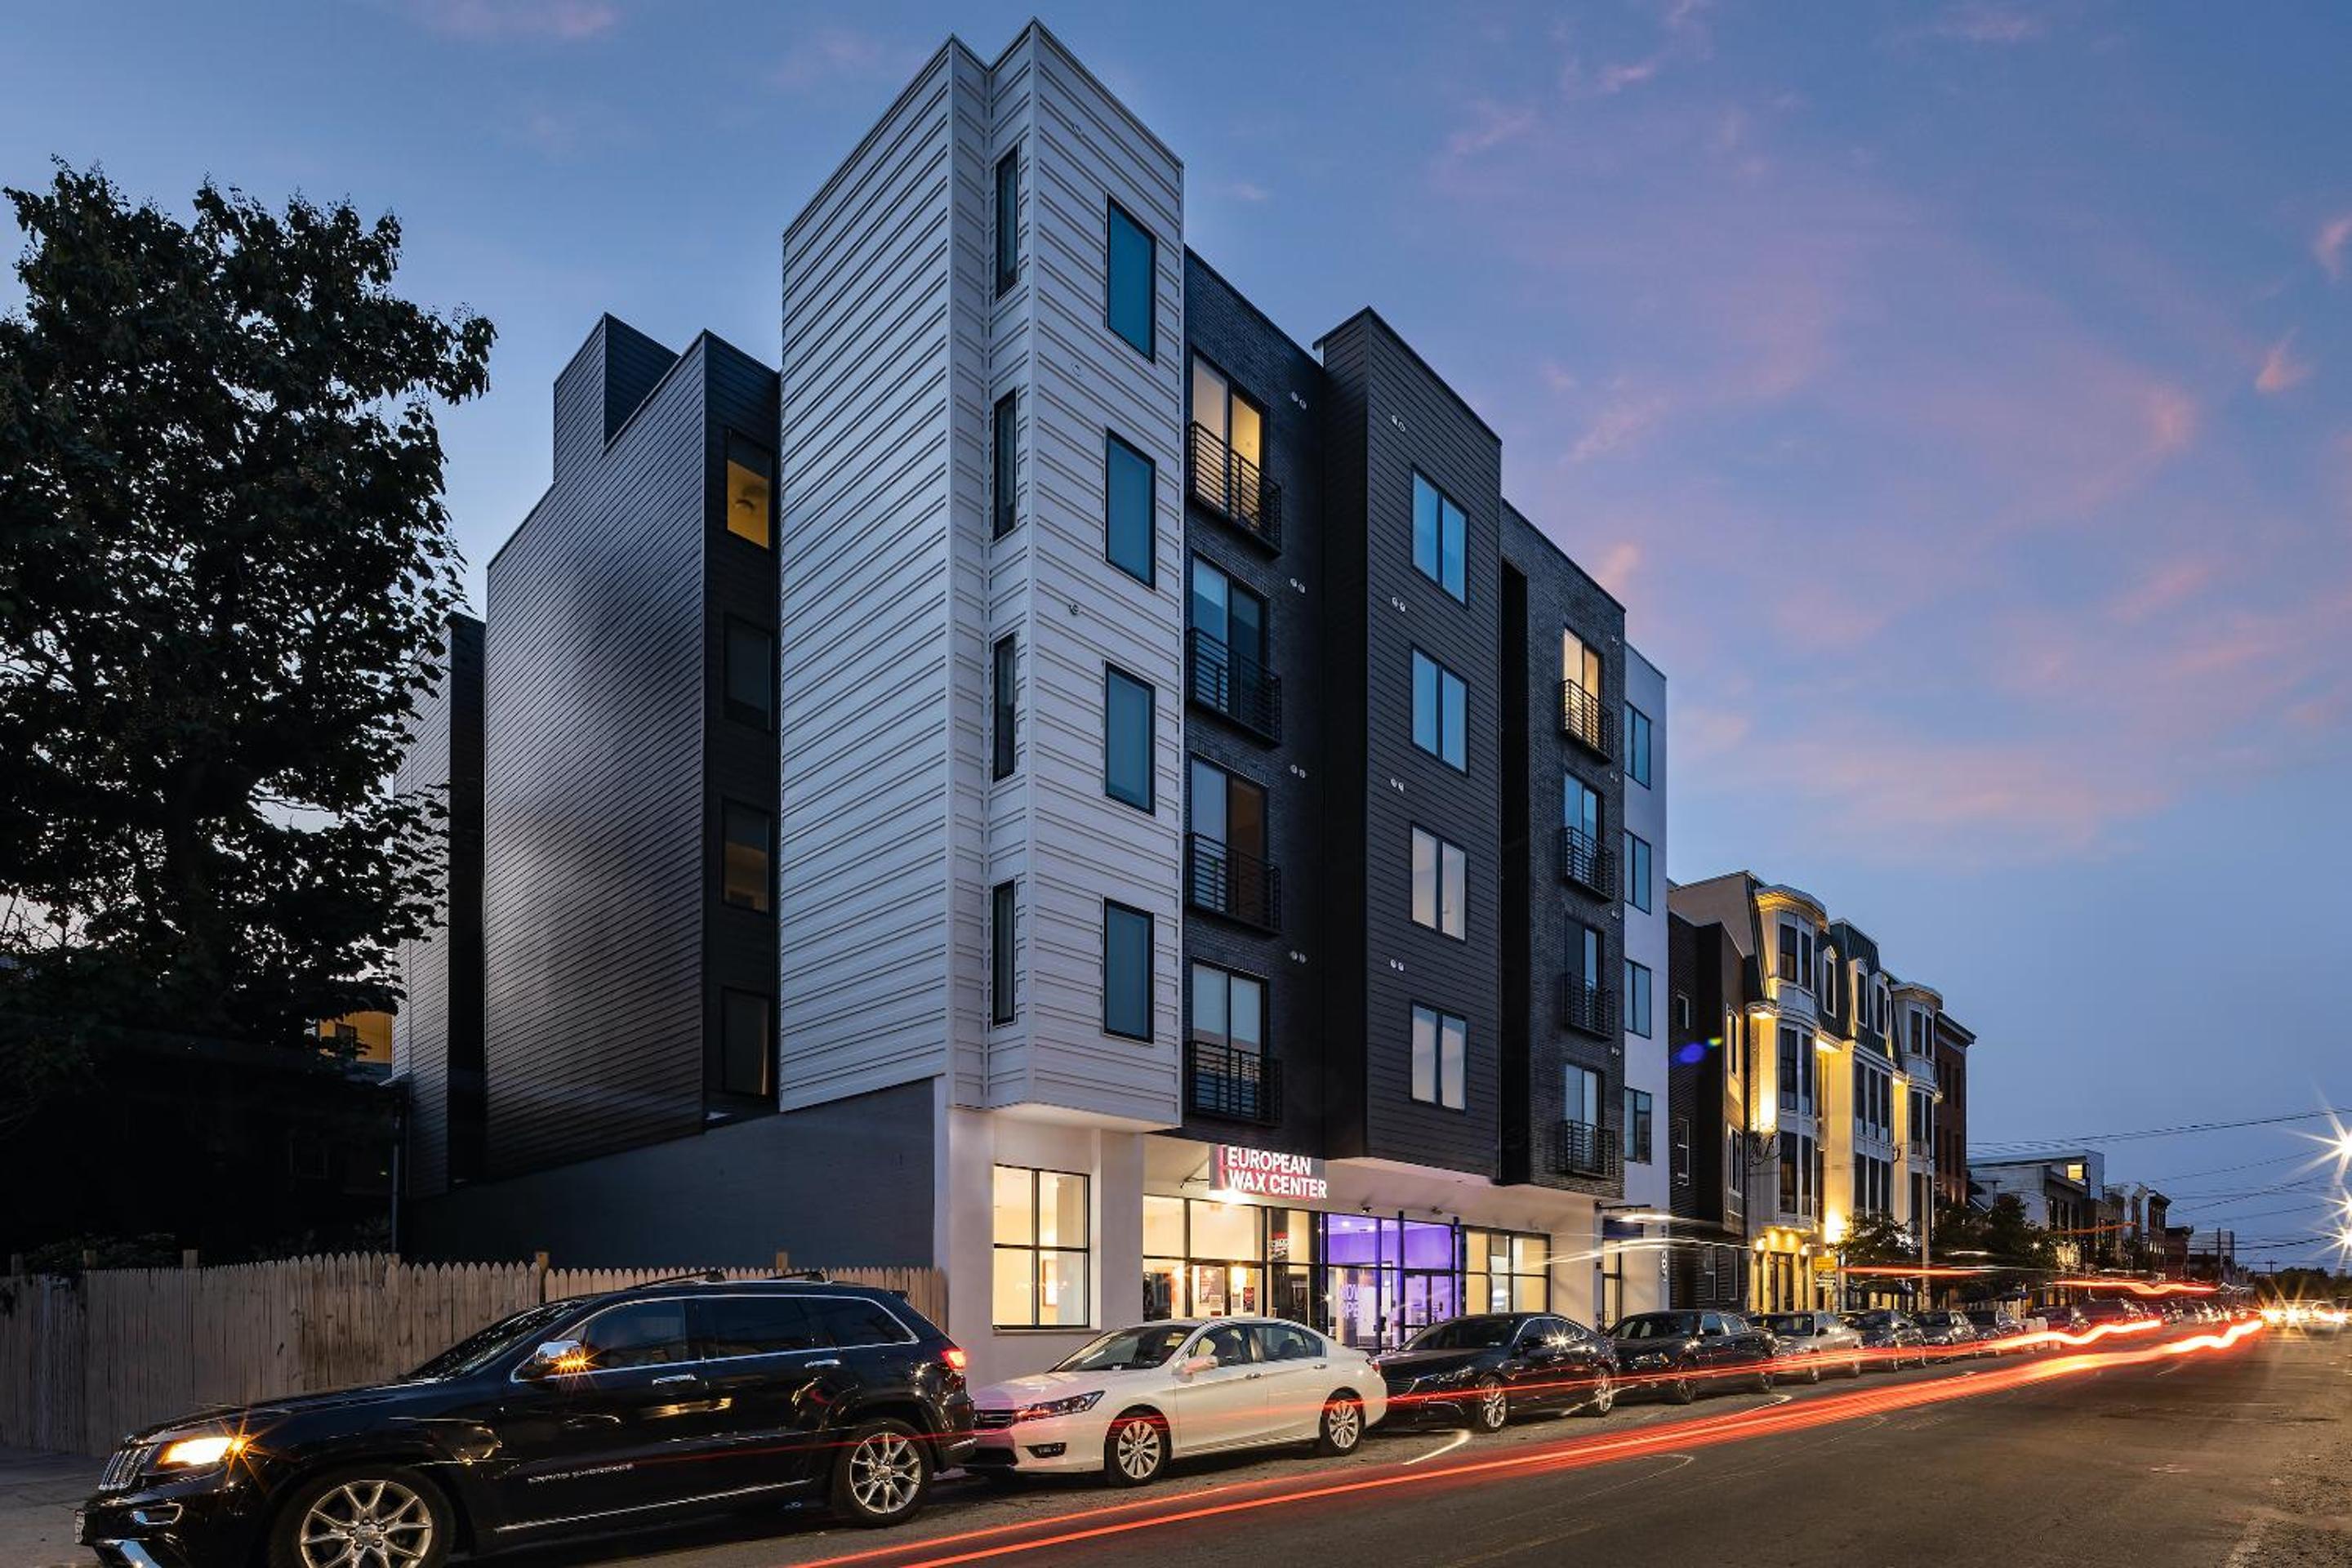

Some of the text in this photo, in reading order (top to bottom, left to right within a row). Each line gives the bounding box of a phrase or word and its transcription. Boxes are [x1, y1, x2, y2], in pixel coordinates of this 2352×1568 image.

[1227, 1146, 1312, 1175] EUROPEAN
[1228, 1169, 1327, 1199] WAX CENTER
